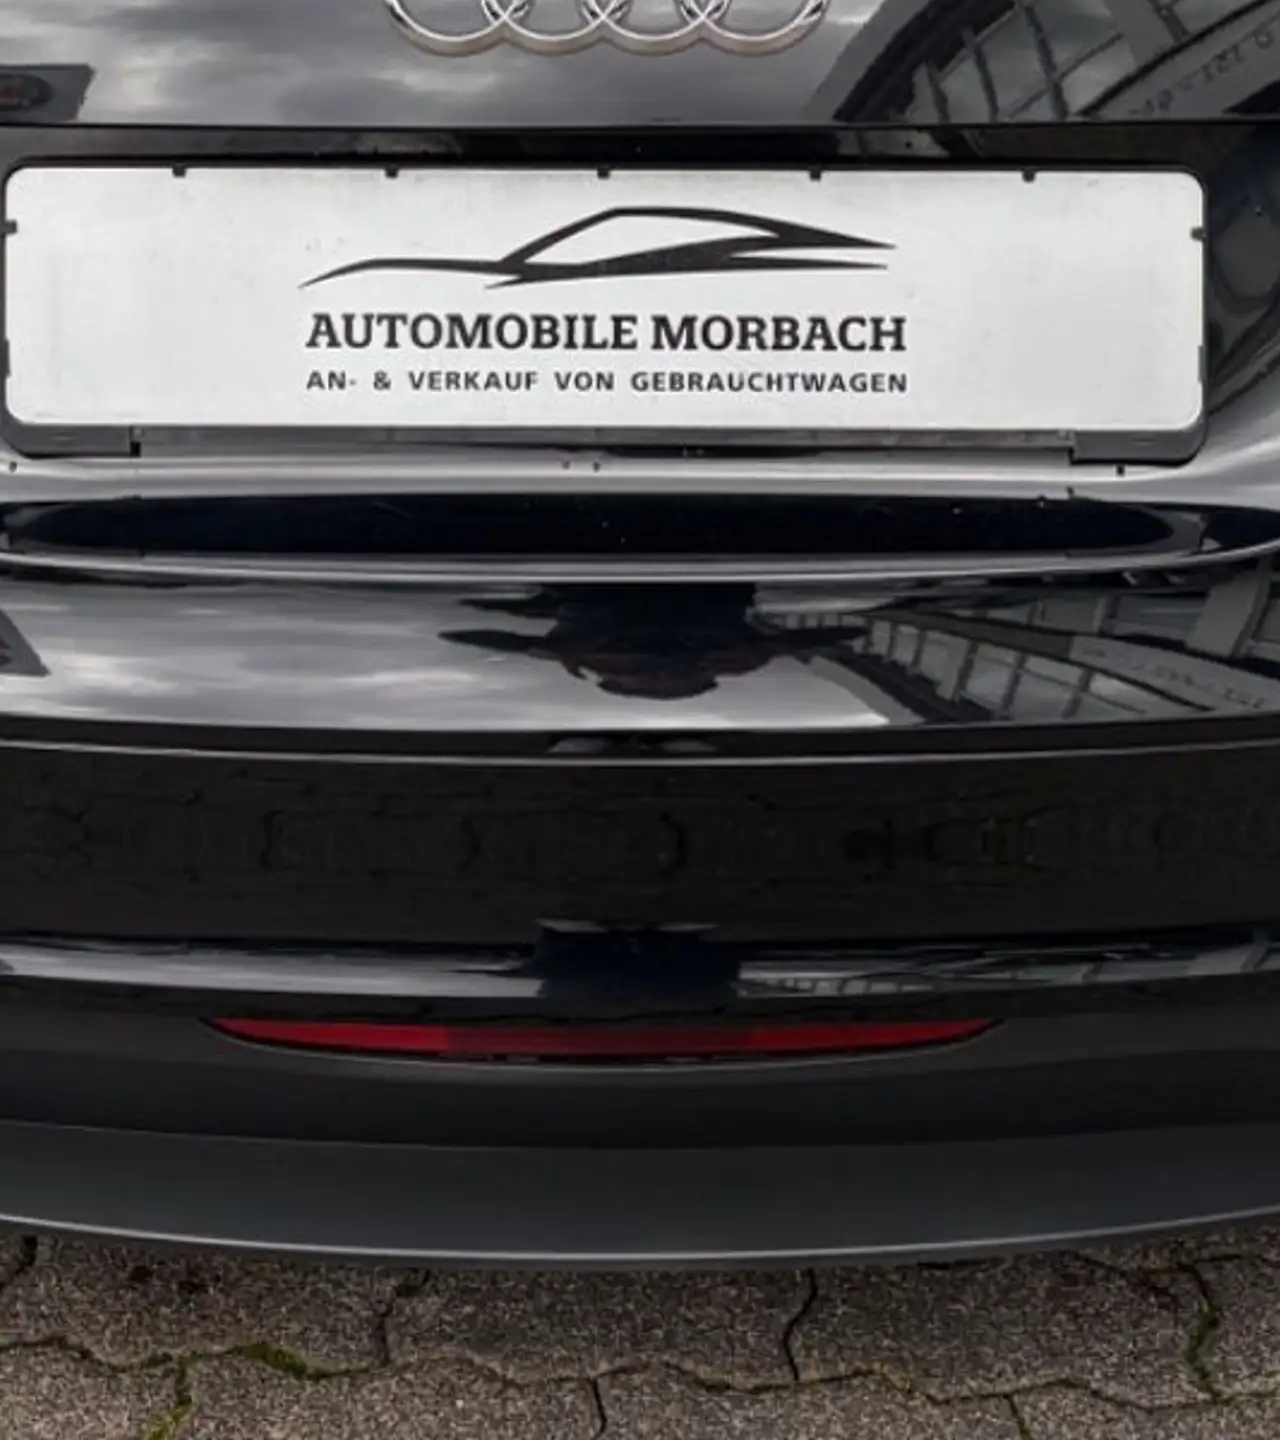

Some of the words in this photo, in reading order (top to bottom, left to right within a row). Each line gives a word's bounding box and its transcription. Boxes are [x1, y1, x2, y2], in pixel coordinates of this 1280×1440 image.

[305, 313, 638, 351] AUTOMOBILE
[651, 315, 908, 352] MORBACH
[305, 371, 358, 392] AN-
[373, 371, 392, 393] &
[408, 370, 541, 393] VERKAUF
[554, 371, 615, 392] VON
[630, 371, 908, 395] GEBRAUCHTWAGEN
